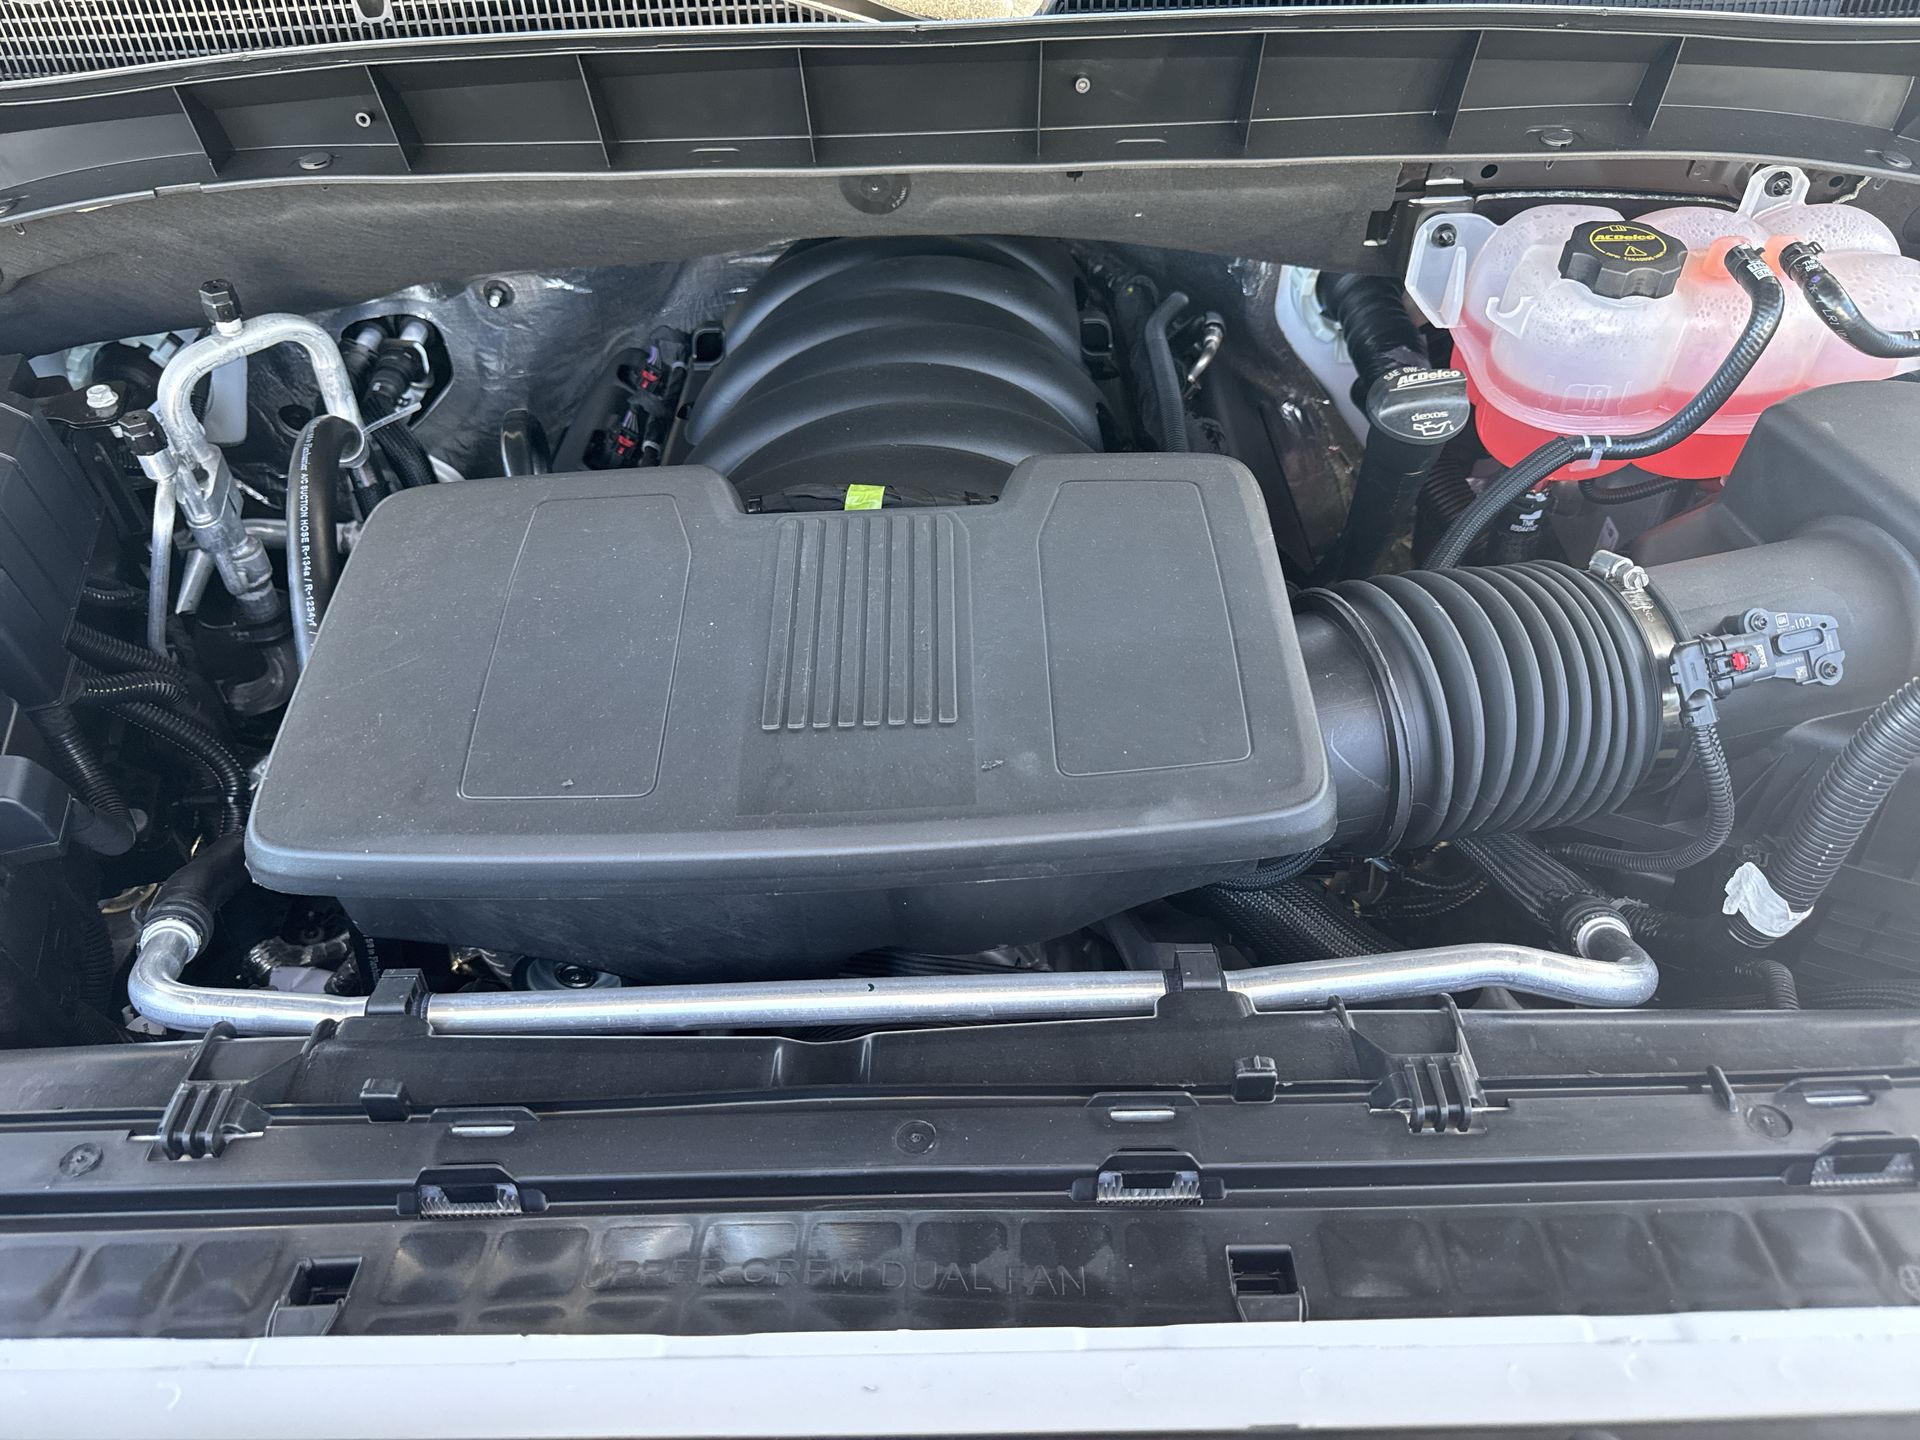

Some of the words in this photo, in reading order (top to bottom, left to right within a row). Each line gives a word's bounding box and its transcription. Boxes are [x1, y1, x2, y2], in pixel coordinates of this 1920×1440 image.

[1594, 234, 1656, 242] ACDelco
[1383, 369, 1401, 382] SAE
[1397, 369, 1461, 387] ACDelco
[1411, 411, 1449, 422] dexos
[300, 485, 309, 519] SUCTION
[300, 519, 310, 544] HOSE
[301, 545, 312, 577] R-134a
[304, 583, 317, 627] R-1234yf
[881, 1260, 992, 1293] DUAL
[1006, 1264, 1087, 1297] FAN
